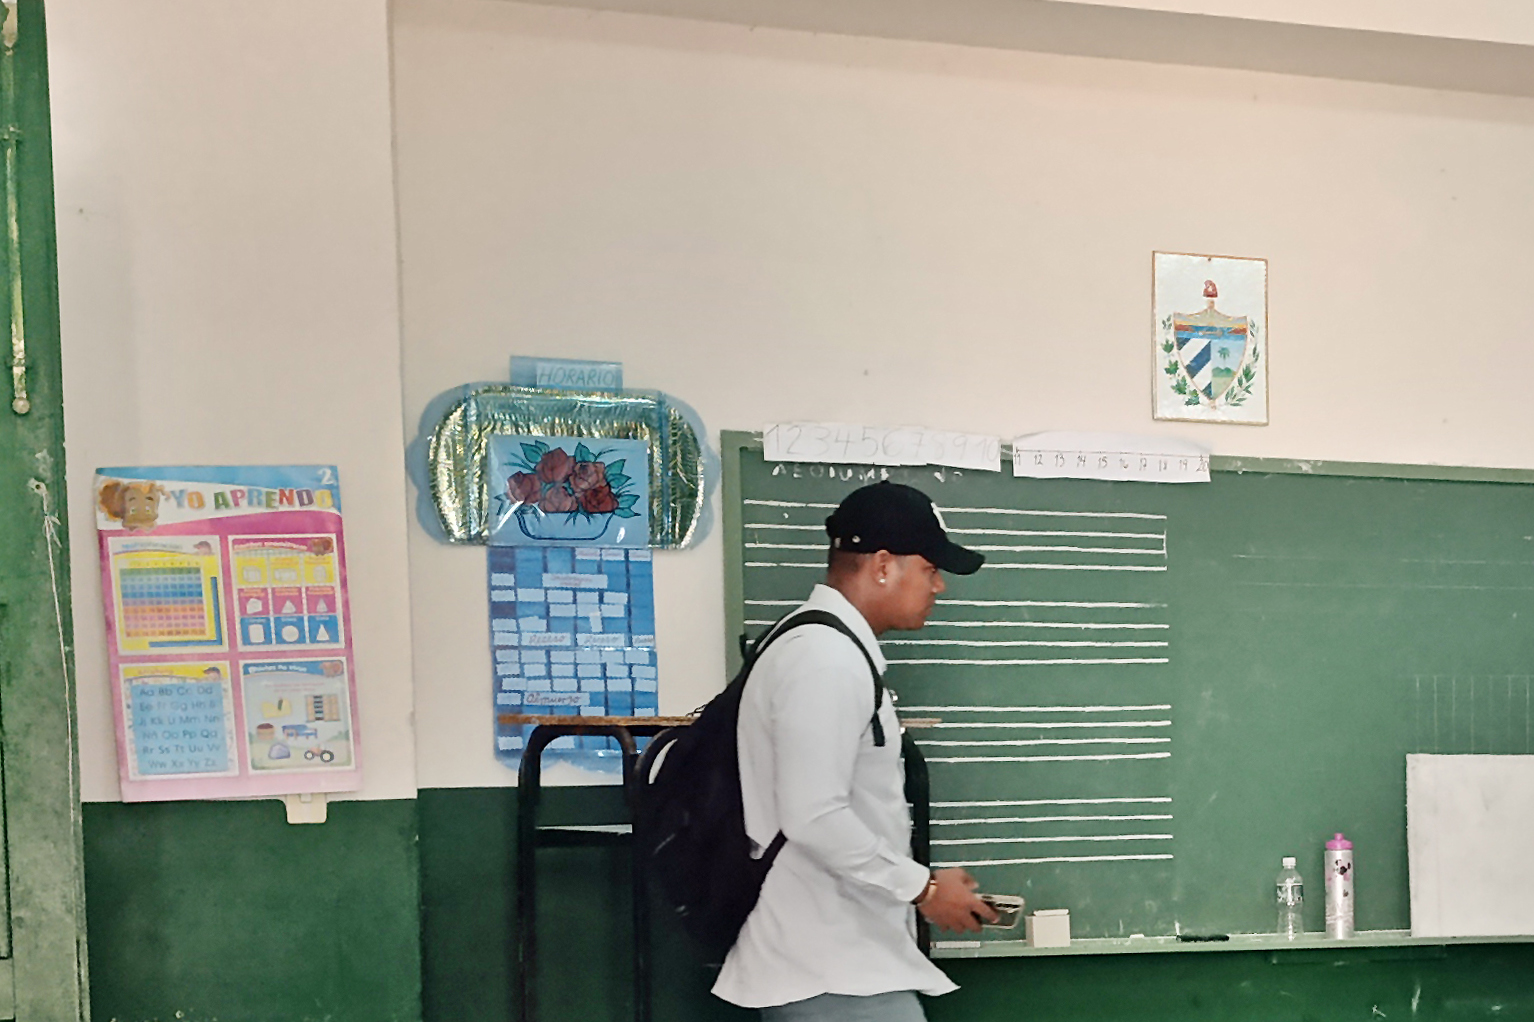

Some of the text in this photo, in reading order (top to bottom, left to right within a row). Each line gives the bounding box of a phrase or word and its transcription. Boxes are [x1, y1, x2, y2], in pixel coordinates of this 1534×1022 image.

[540, 365, 615, 387] HORARIO
[765, 424, 780, 456] 1
[786, 424, 801, 455] 2
[813, 426, 830, 456] 3
[833, 427, 855, 456] 4
[862, 427, 878, 457] 5
[953, 434, 967, 460] 9
[1013, 455, 1021, 466] 11
[1034, 454, 1043, 466] 12
[1055, 454, 1065, 468] 13
[1077, 455, 1086, 468] 14
[1098, 456, 1108, 469] 15
[1179, 459, 1188, 470] 19
[1196, 460, 1209, 472] 20
[317, 468, 334, 485] 2
[170, 488, 333, 510] YO APRENDO
